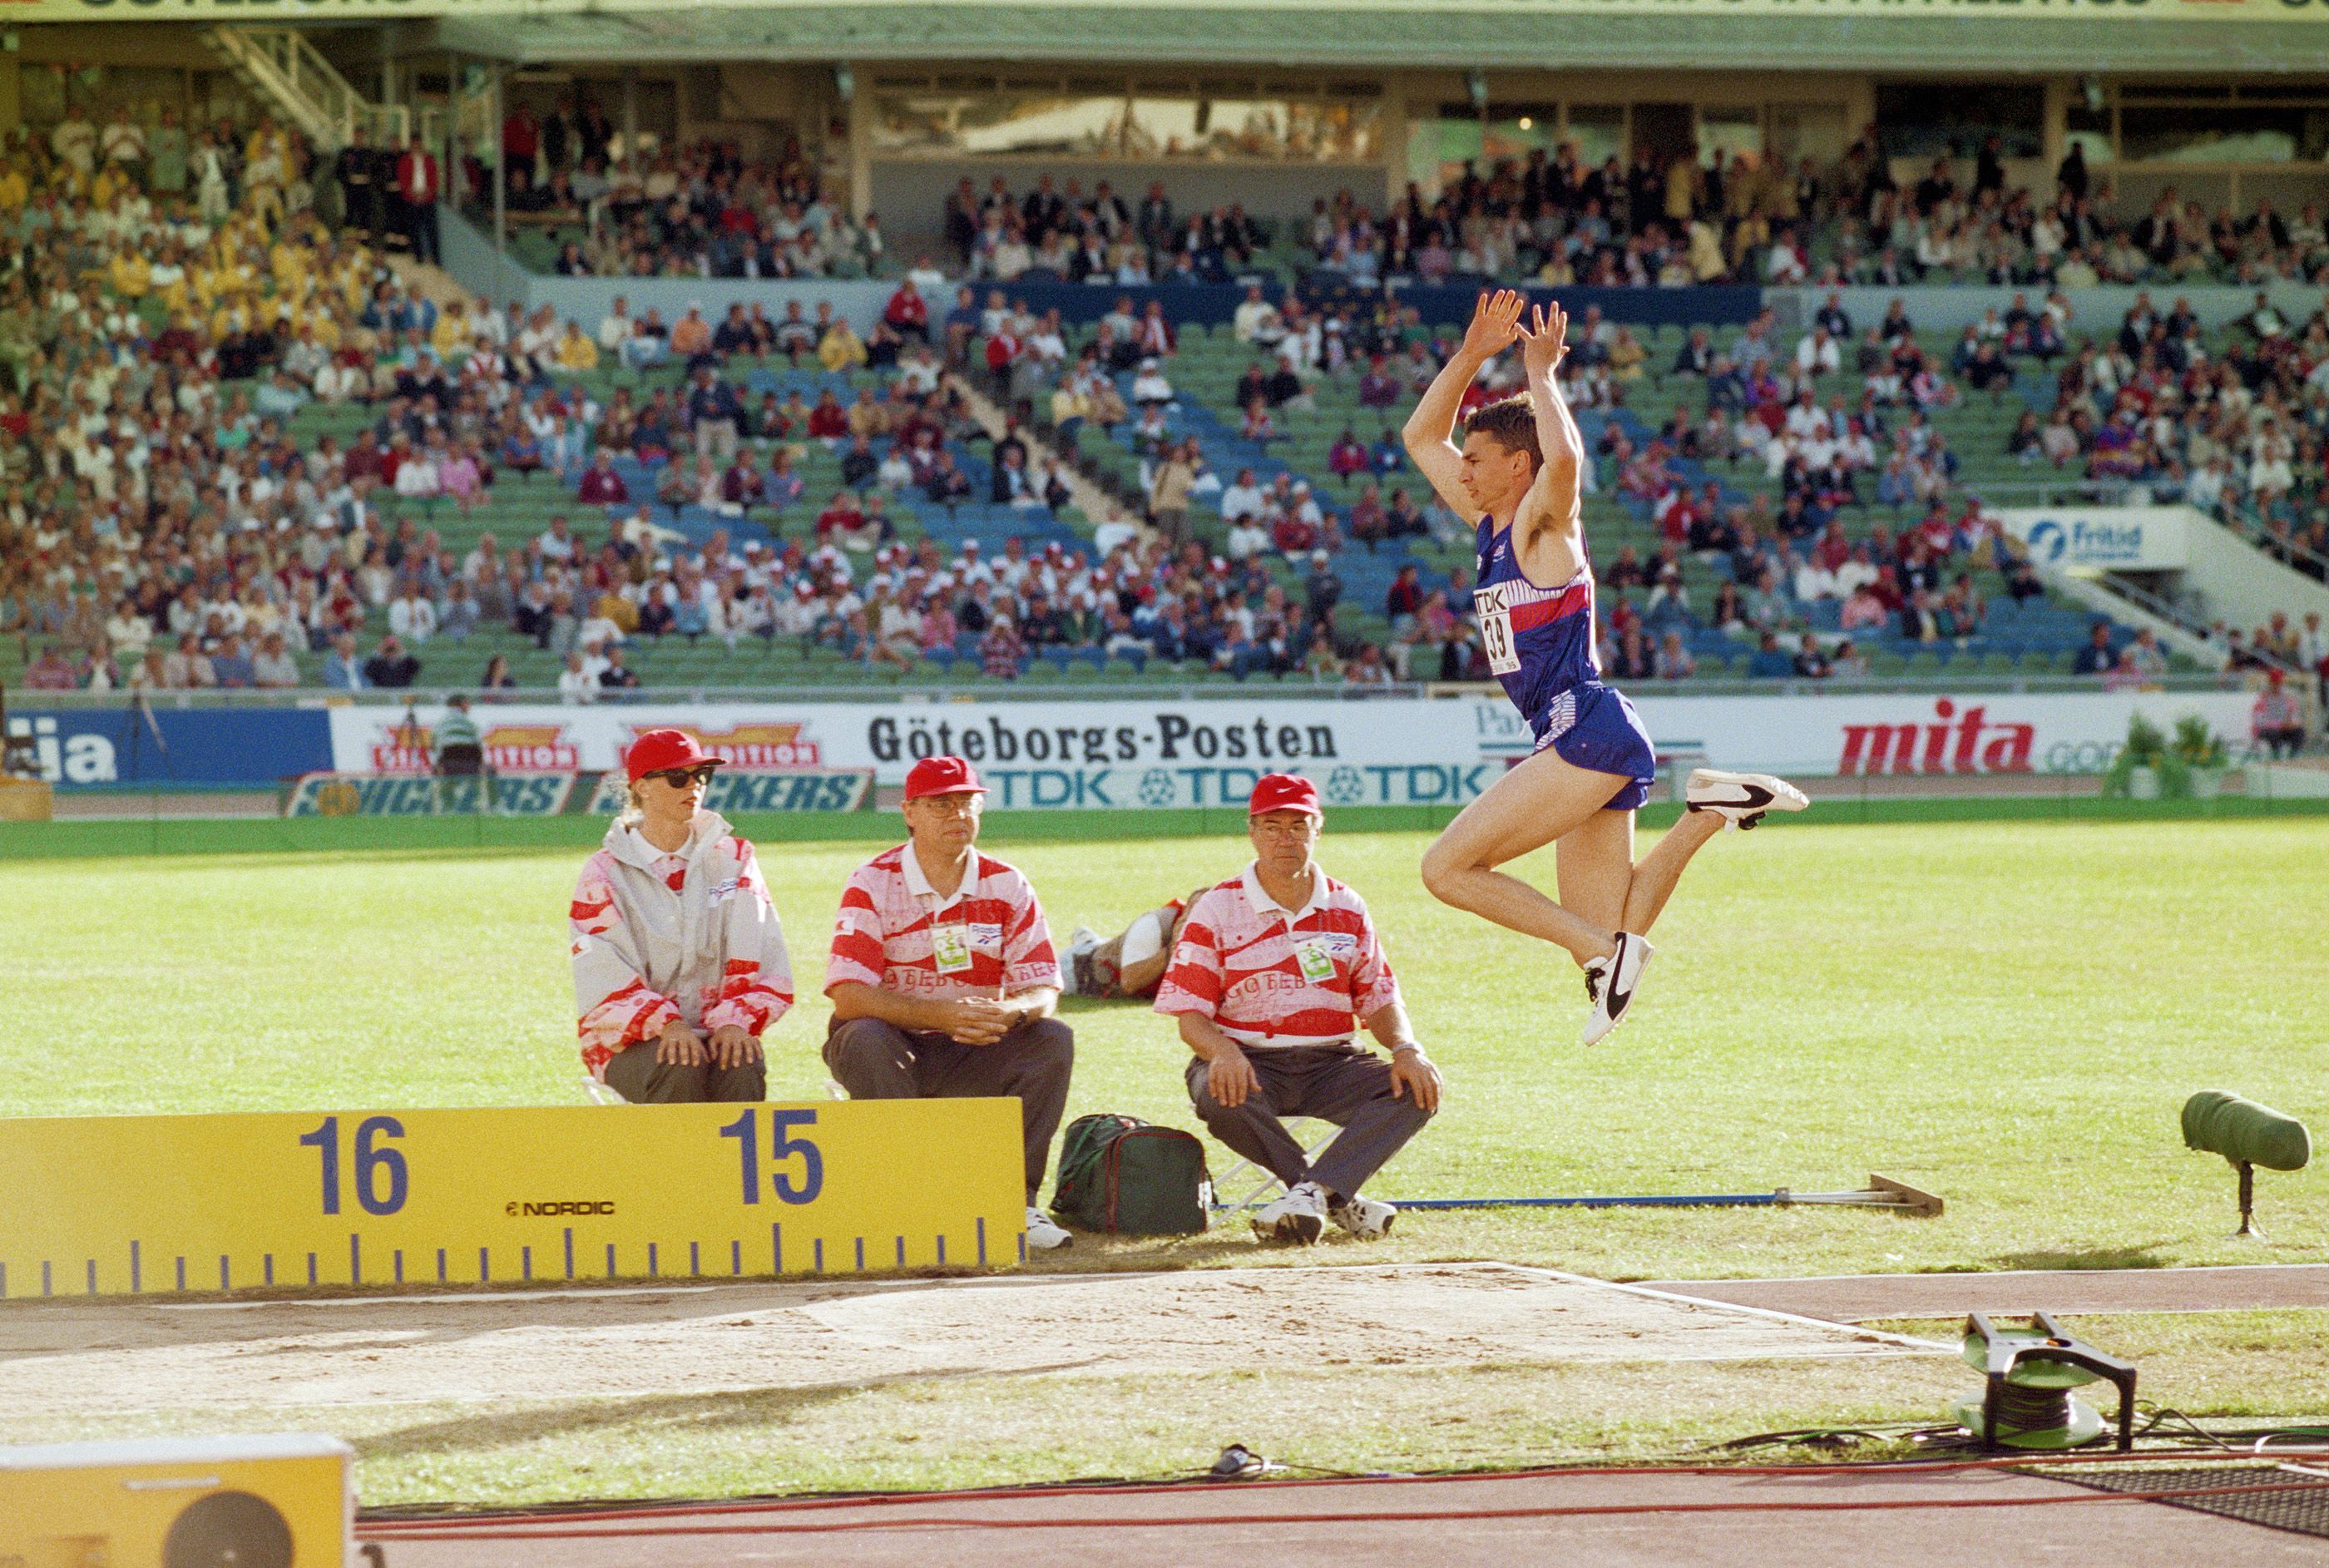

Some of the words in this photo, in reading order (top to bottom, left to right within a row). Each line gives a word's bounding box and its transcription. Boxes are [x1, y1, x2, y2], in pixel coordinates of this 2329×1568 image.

[1475, 589, 1507, 615] TDK
[1484, 616, 1507, 660] 39
[869, 715, 1338, 763] Göteborgs-Posten
[1837, 695, 2035, 774] mita
[986, 769, 1113, 806] TDK
[1175, 767, 1301, 804] TD
[1364, 765, 1490, 801] TDK
[299, 1115, 408, 1216] 16
[719, 1108, 823, 1204] 15
[523, 1201, 615, 1216] NORDIC
